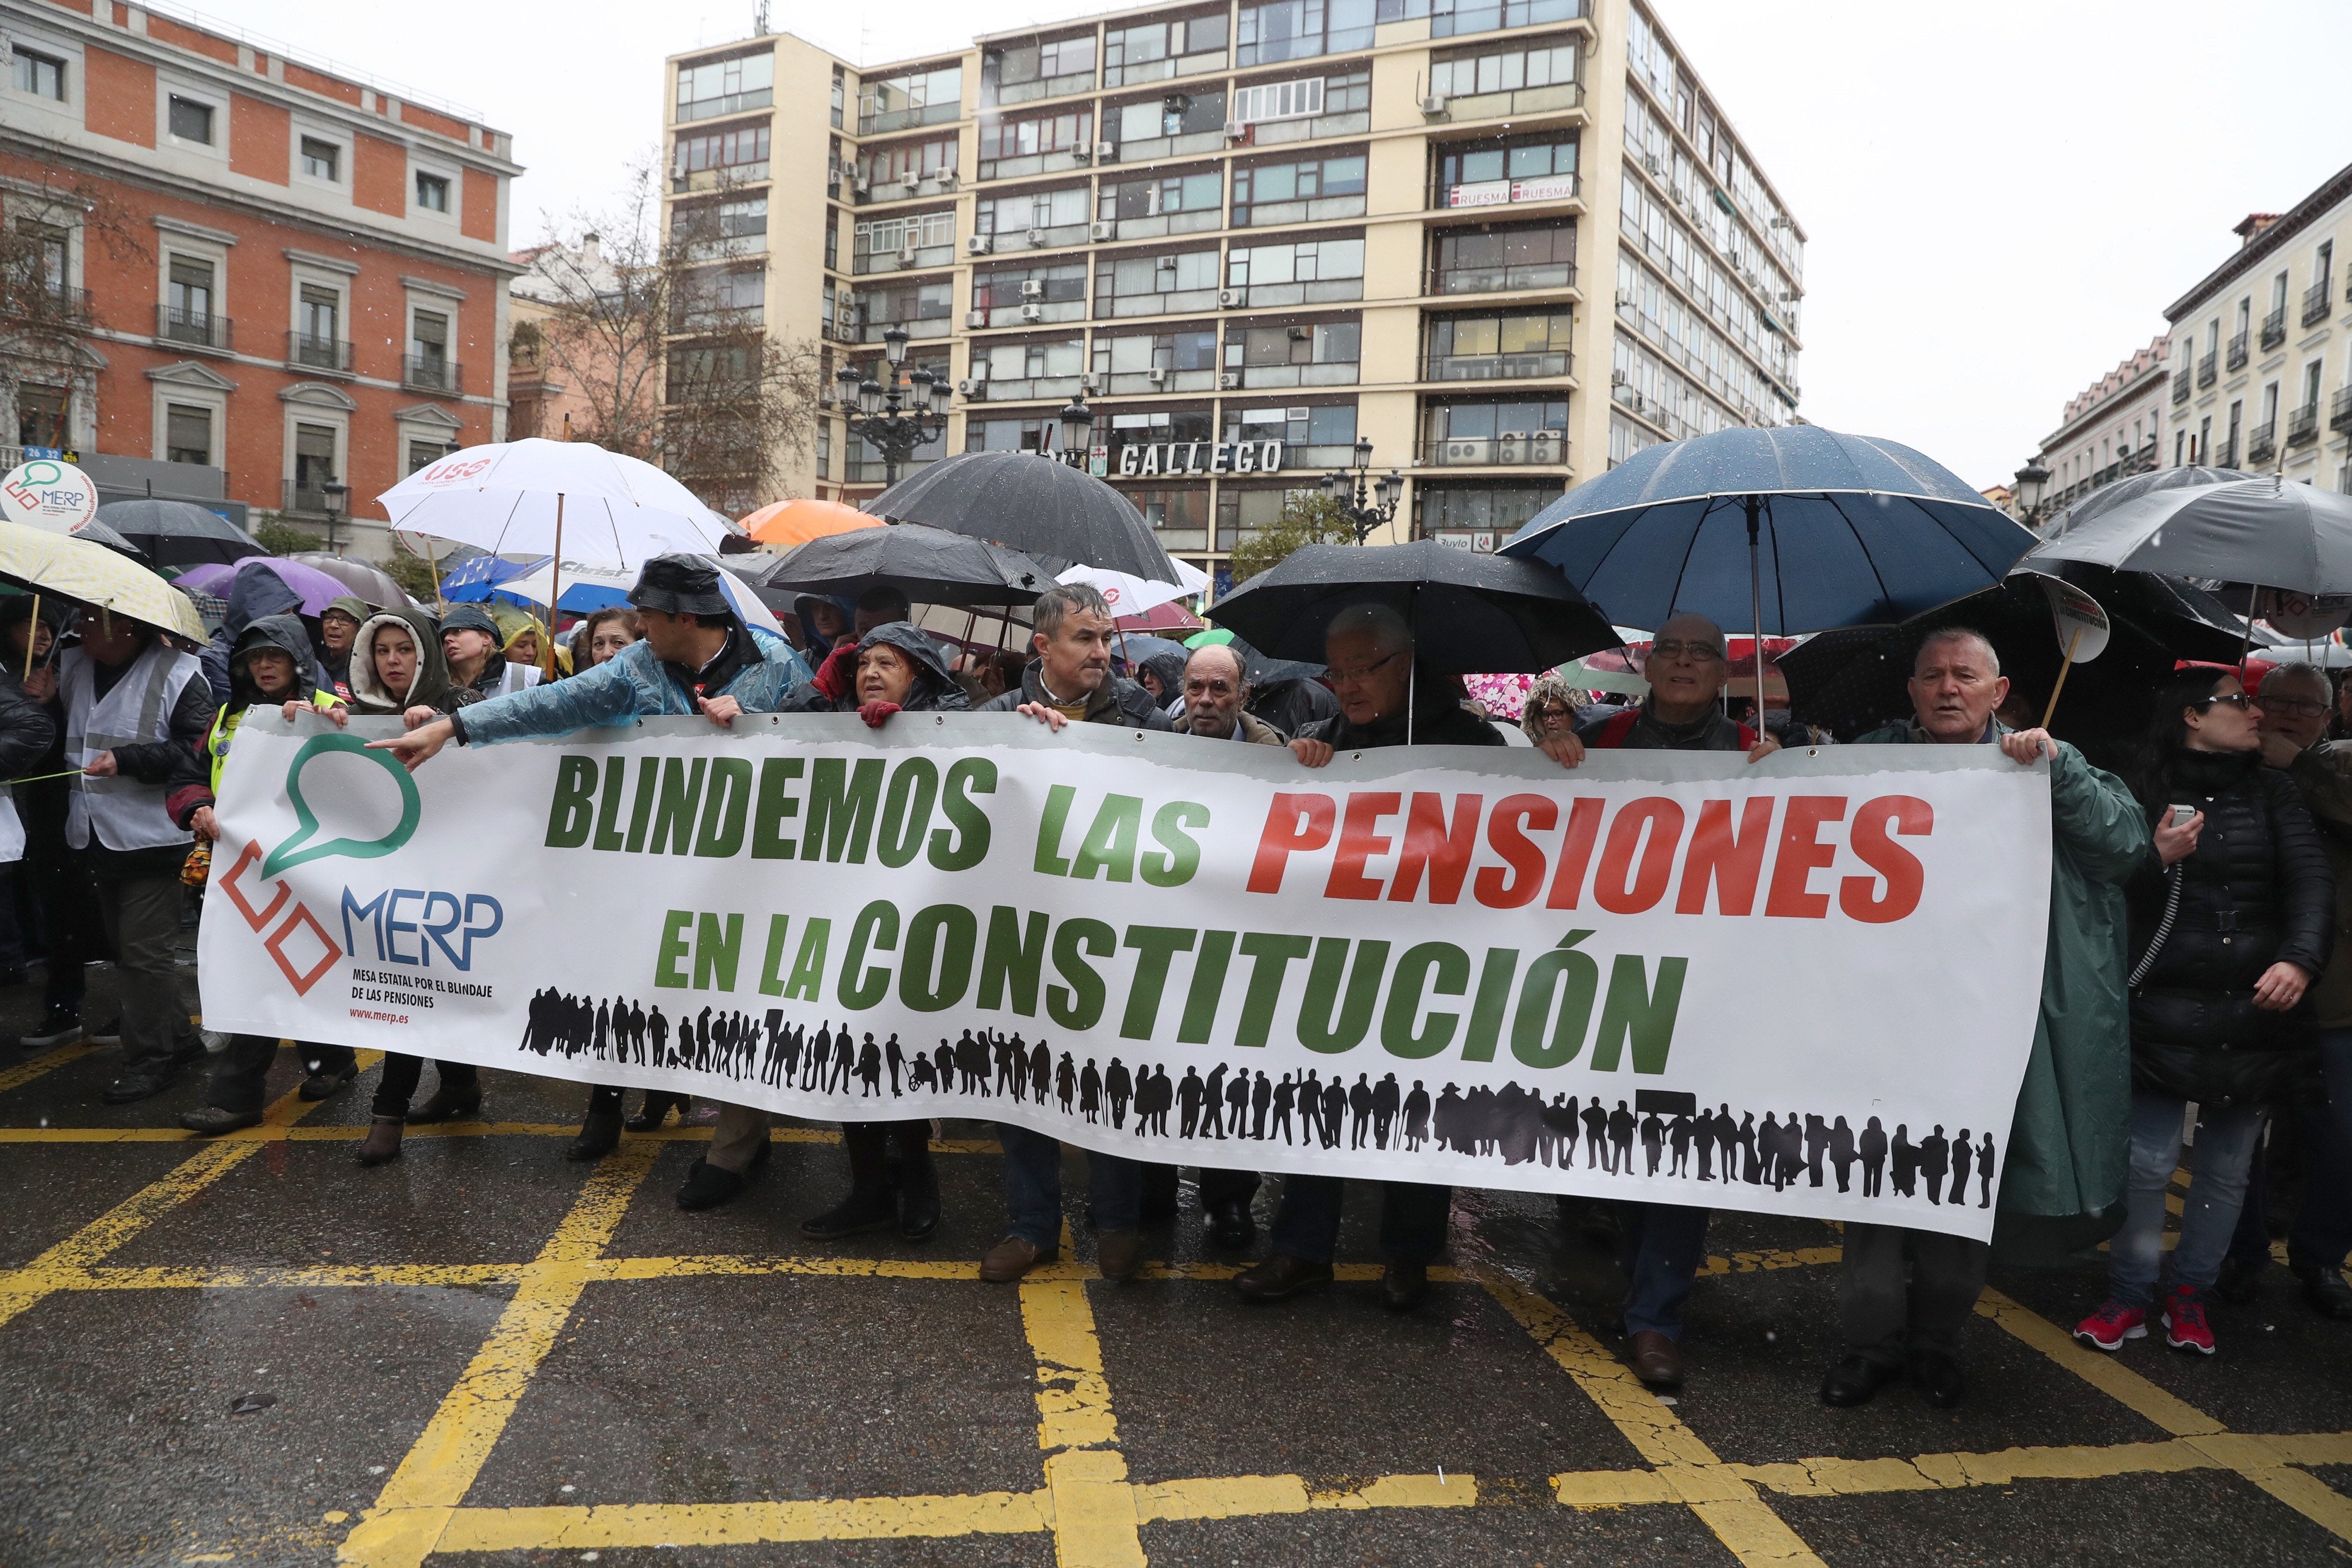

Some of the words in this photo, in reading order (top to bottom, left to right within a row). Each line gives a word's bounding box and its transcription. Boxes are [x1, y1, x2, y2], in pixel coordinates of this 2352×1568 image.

[1460, 191, 1507, 204] RUESMA
[1522, 186, 1571, 199] RUESMA
[28, 447, 41, 457] 26
[47, 448, 59, 459] 32
[1120, 441, 1281, 475] GALLEGO
[42, 489, 84, 507] MERP
[559, 561, 634, 577] Christ
[544, 755, 998, 872] BLINDEMOS
[1033, 783, 1210, 887] LAS
[1246, 791, 1934, 924] PENSIONES
[341, 884, 503, 972] MERP
[353, 969, 376, 983] MESA
[379, 972, 413, 987] ESTATAL
[415, 977, 434, 990] POR
[435, 979, 446, 992] EL
[448, 982, 492, 998] BLINDAJE
[654, 909, 744, 993] EN
[758, 914, 832, 1003] LA
[837, 899, 1688, 1075] CONSTITUCIÓN
[351, 986, 364, 999] DE
[366, 988, 381, 1001] LAS
[384, 990, 434, 1008] PENSIONES
[350, 1008, 409, 1025] www.merp.es
